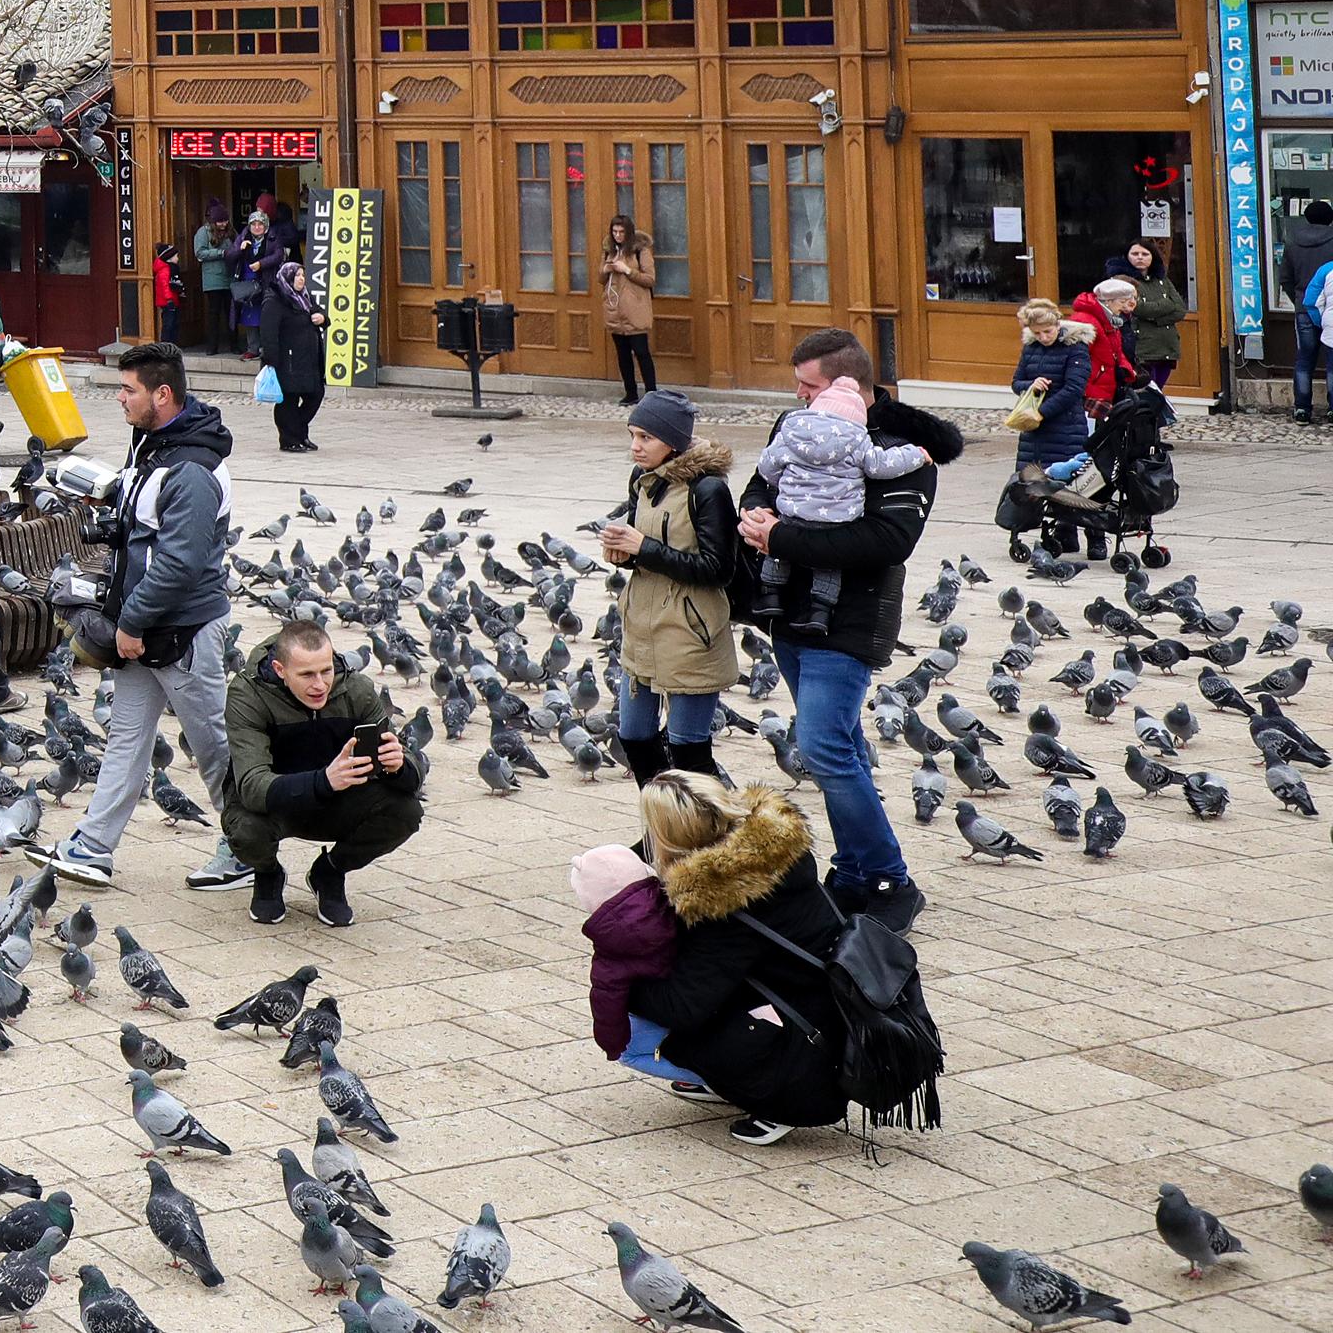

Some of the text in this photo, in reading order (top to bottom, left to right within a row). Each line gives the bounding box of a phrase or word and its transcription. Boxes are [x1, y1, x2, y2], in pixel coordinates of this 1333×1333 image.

[1300, 59, 1333, 72] Mic
[1301, 28, 1333, 37] brillian
[1227, 17, 1249, 152] PRODAJA
[100, 166, 110, 174] 13
[220, 132, 317, 156] OFFICE
[120, 132, 132, 266] EXCHANGE
[354, 200, 376, 375] MJENJAČNICA
[1236, 195, 1257, 328] ZAMJENA
